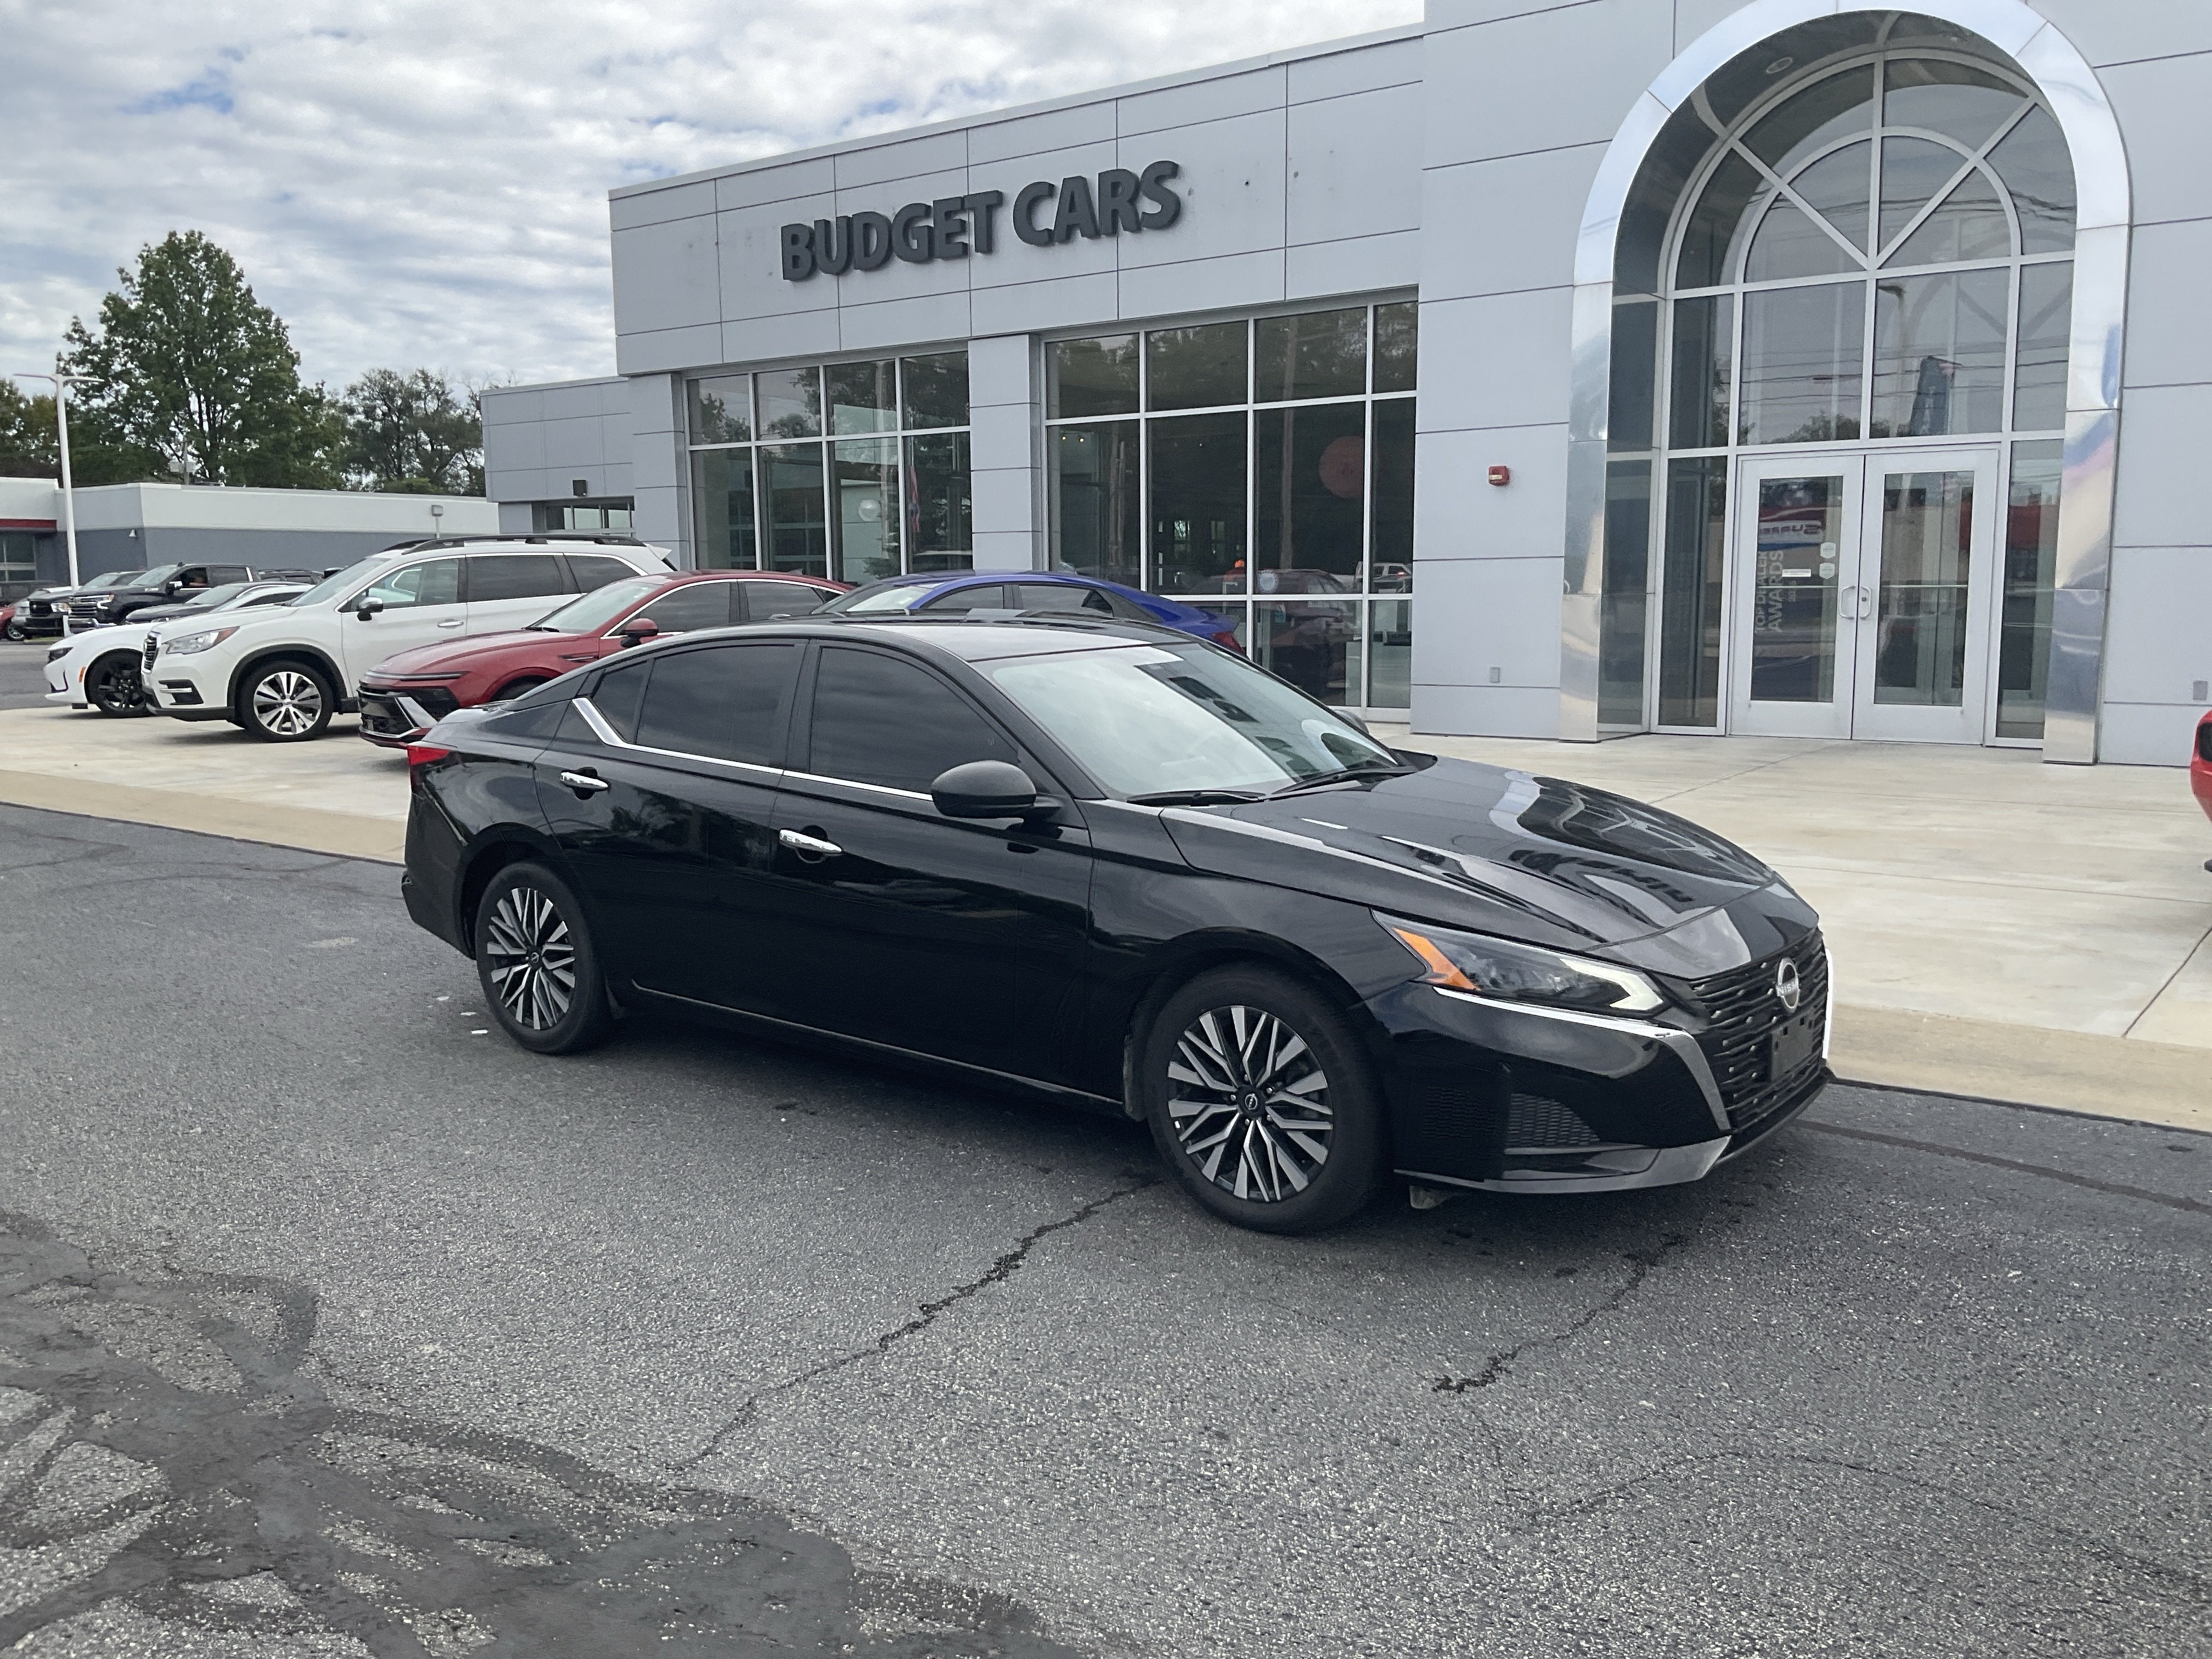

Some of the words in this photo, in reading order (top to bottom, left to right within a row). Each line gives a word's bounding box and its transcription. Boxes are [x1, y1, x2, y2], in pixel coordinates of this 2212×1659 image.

[781, 190, 1003, 281] BUDGET
[1013, 160, 1181, 247] CARS
[1768, 550, 1783, 632] AWARDS
